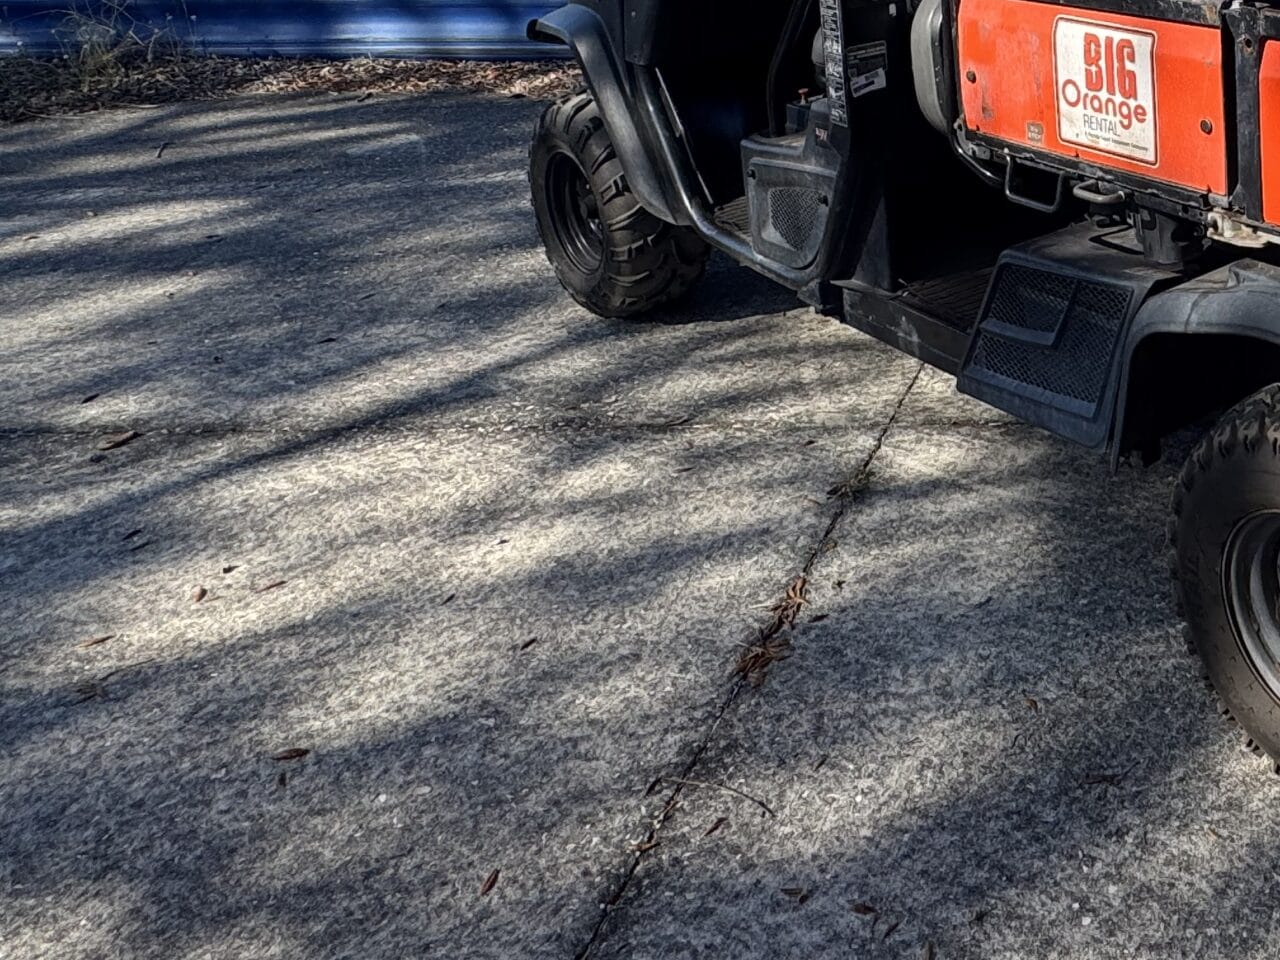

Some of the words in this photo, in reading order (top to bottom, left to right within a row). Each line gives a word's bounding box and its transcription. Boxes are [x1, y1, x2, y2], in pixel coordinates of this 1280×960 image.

[1084, 32, 1138, 101] BIG
[1062, 79, 1148, 130] Orange
[1083, 114, 1121, 137] RENTAL
